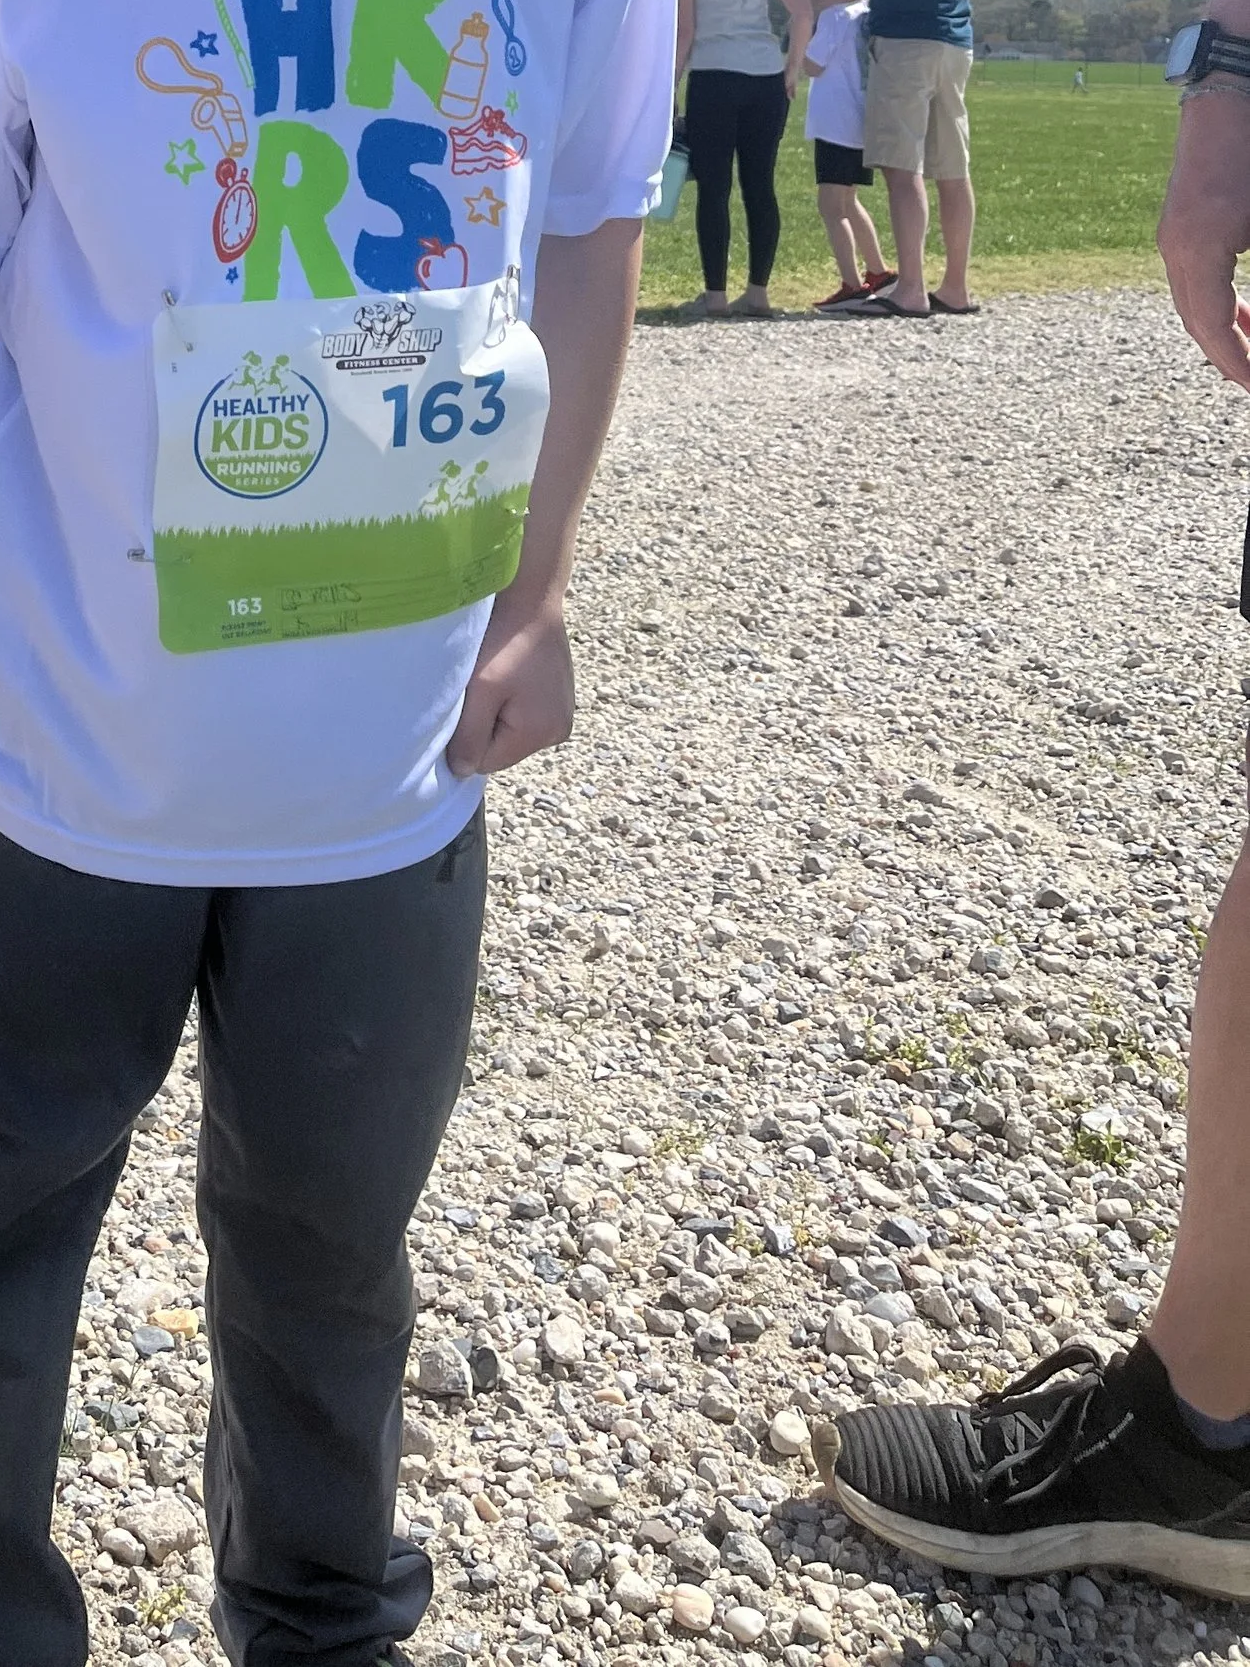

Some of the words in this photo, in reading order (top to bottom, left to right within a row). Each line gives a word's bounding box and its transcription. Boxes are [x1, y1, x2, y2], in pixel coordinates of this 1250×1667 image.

[322, 333, 368, 358] BODY
[398, 327, 442, 353] SHOP
[344, 359, 380, 369] FITNESS
[382, 357, 418, 366] CENTER
[213, 394, 310, 417] HEALTHY
[382, 369, 507, 448] 163
[211, 413, 310, 453] KIDS
[216, 461, 301, 476] RUNNING
[228, 597, 262, 616] 163
